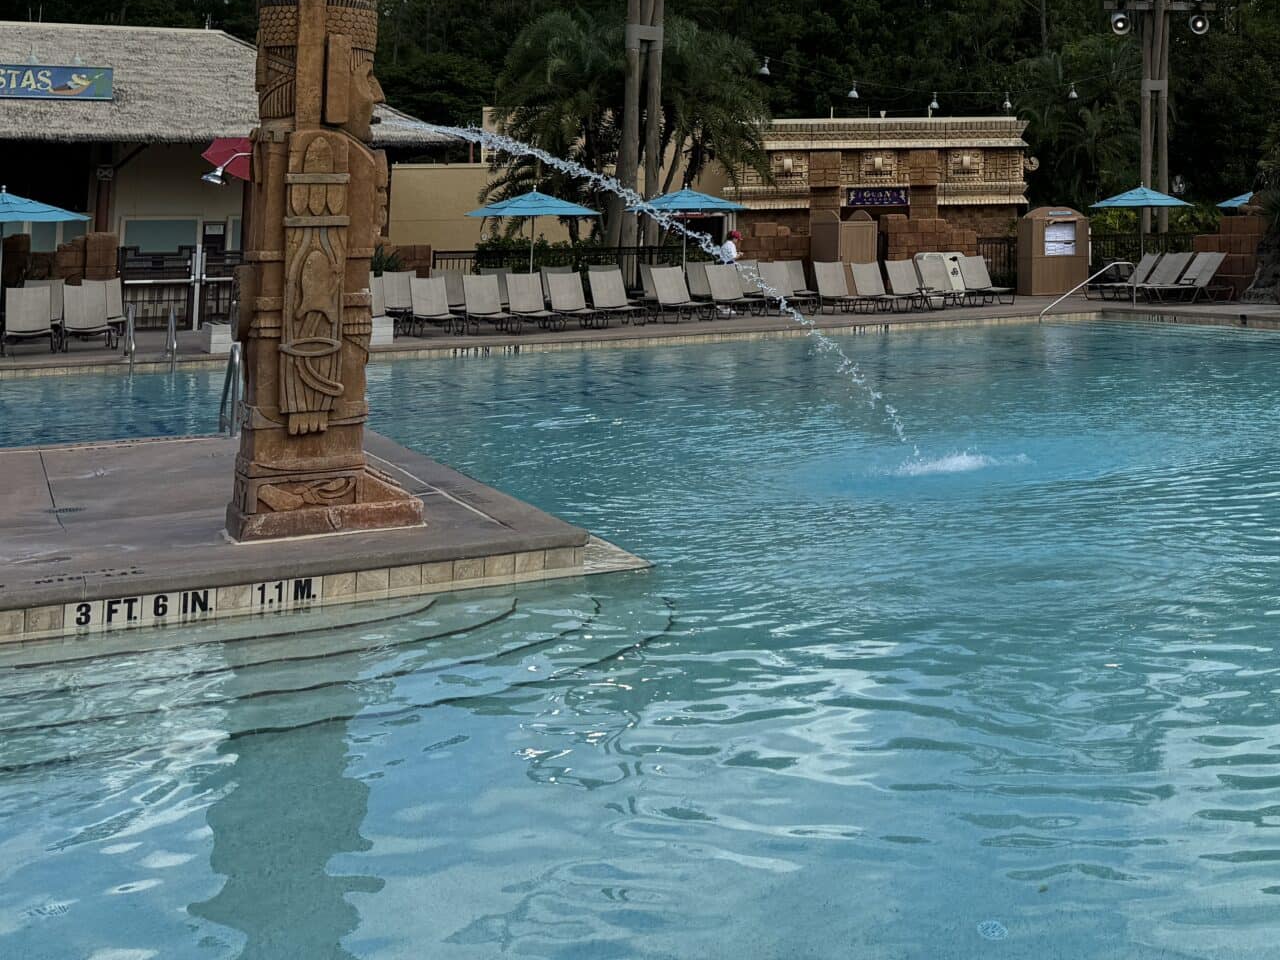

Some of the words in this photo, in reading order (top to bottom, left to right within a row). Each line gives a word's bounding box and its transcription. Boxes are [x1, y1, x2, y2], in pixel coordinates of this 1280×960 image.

[76, 603, 91, 626] 3
[106, 598, 138, 623] FT.
[153, 594, 168, 617] 6
[182, 590, 213, 615] IN.
[257, 581, 283, 604] 1.1
[293, 578, 317, 601] M.
